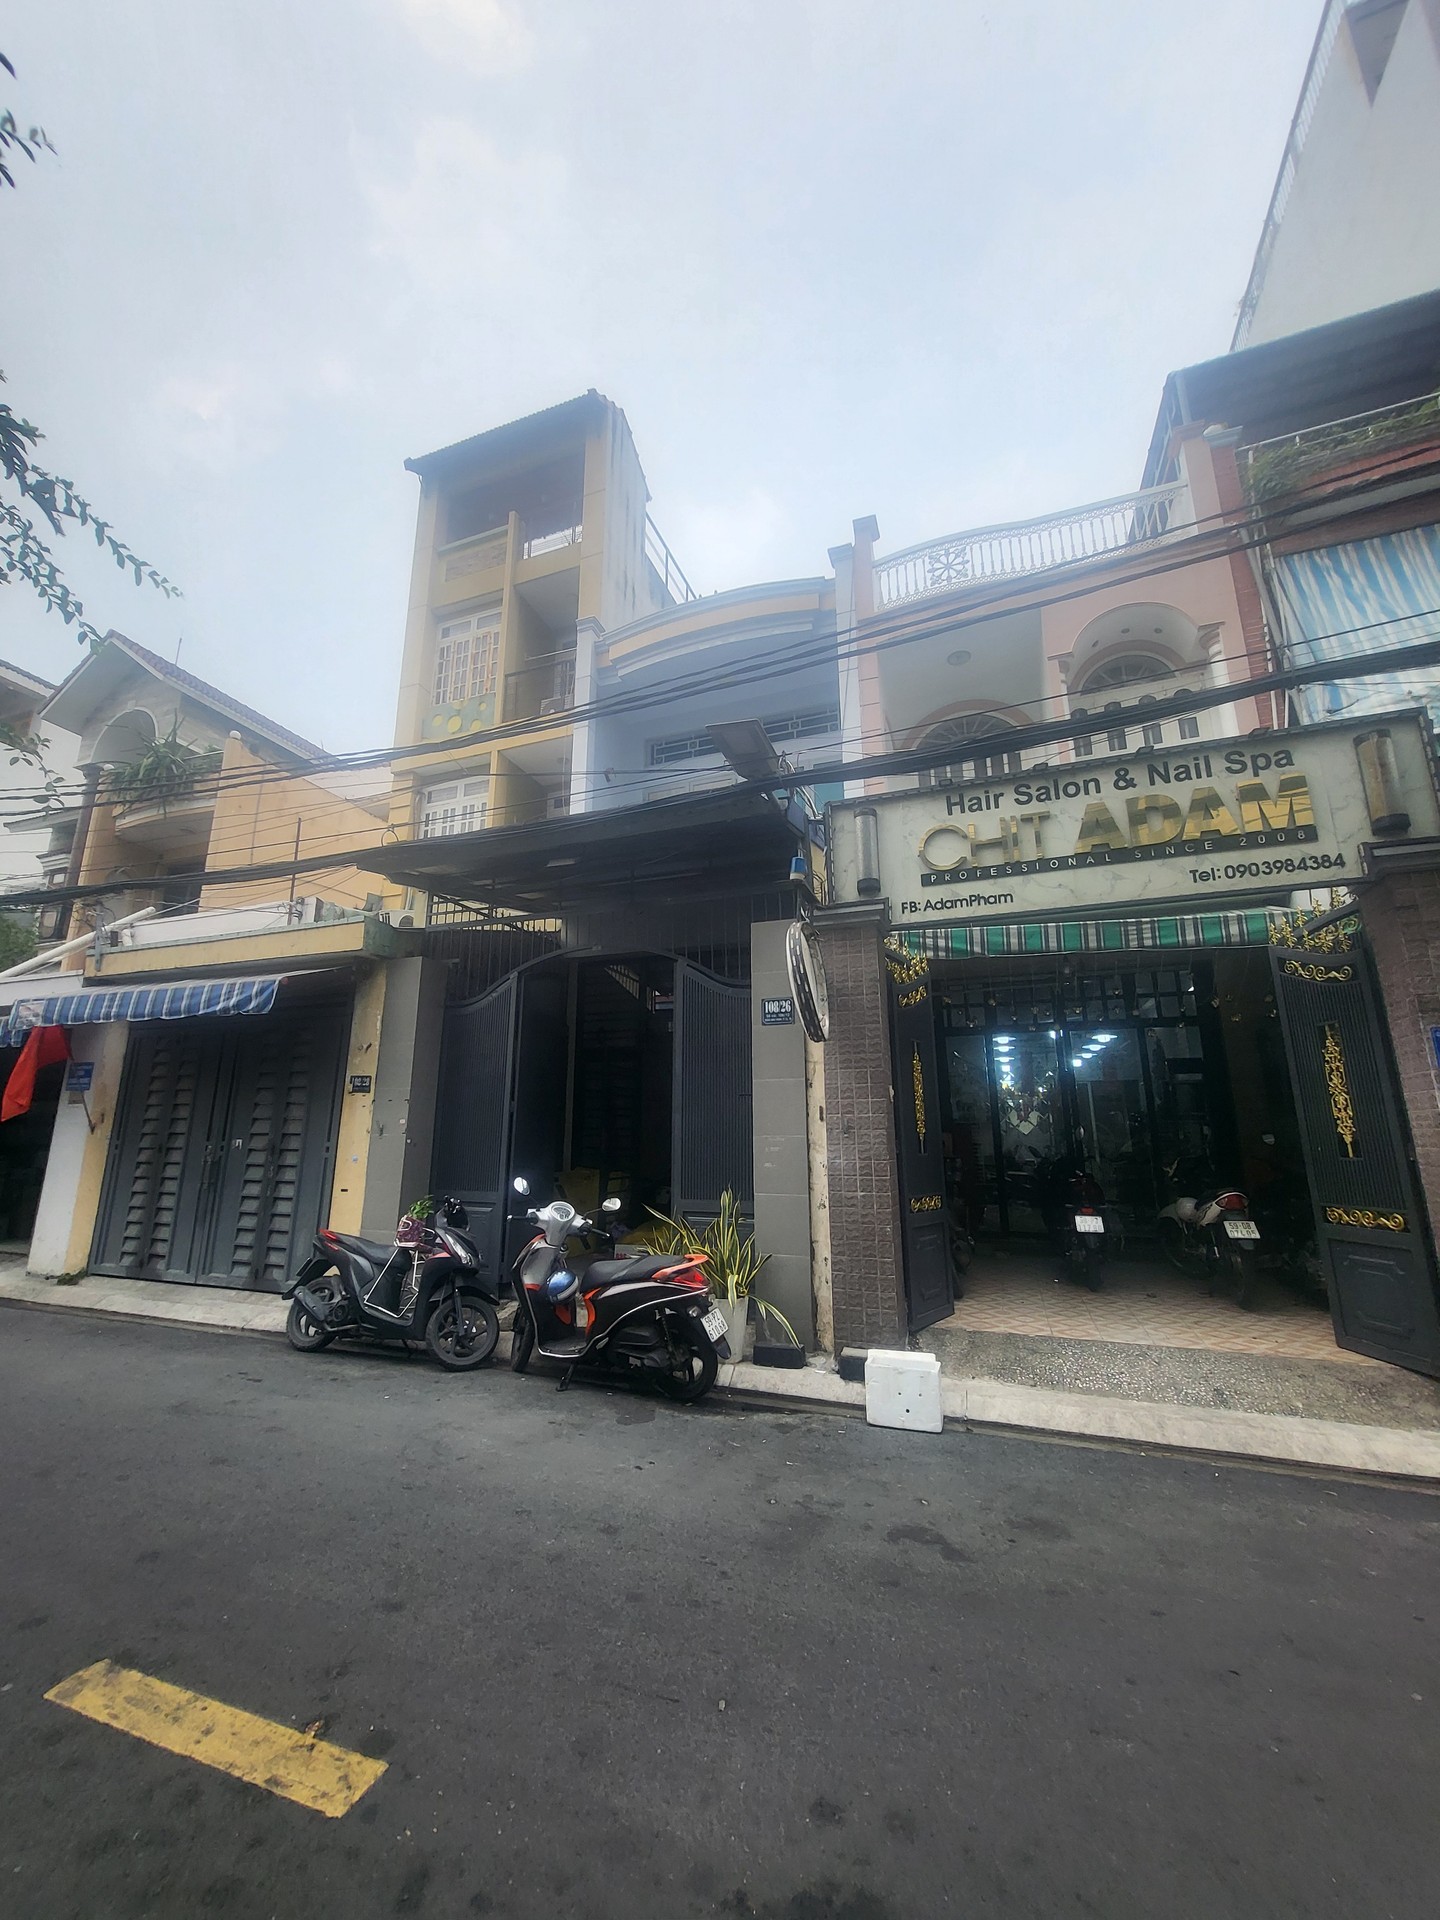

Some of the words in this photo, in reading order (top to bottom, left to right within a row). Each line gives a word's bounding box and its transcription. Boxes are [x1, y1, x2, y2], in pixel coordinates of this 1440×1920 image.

[946, 790, 1004, 816] Hair
[1013, 778, 1101, 806] Salon
[1112, 766, 1137, 791] &
[1147, 754, 1213, 786] Nail
[1224, 749, 1295, 778] Spa
[1074, 773, 1315, 855] ADAM
[930, 854, 1112, 883] PROFESSIONAL
[1134, 840, 1214, 859] SINCE
[1239, 830, 1306, 847] 2008
[765, 999, 791, 1014] 108/26
